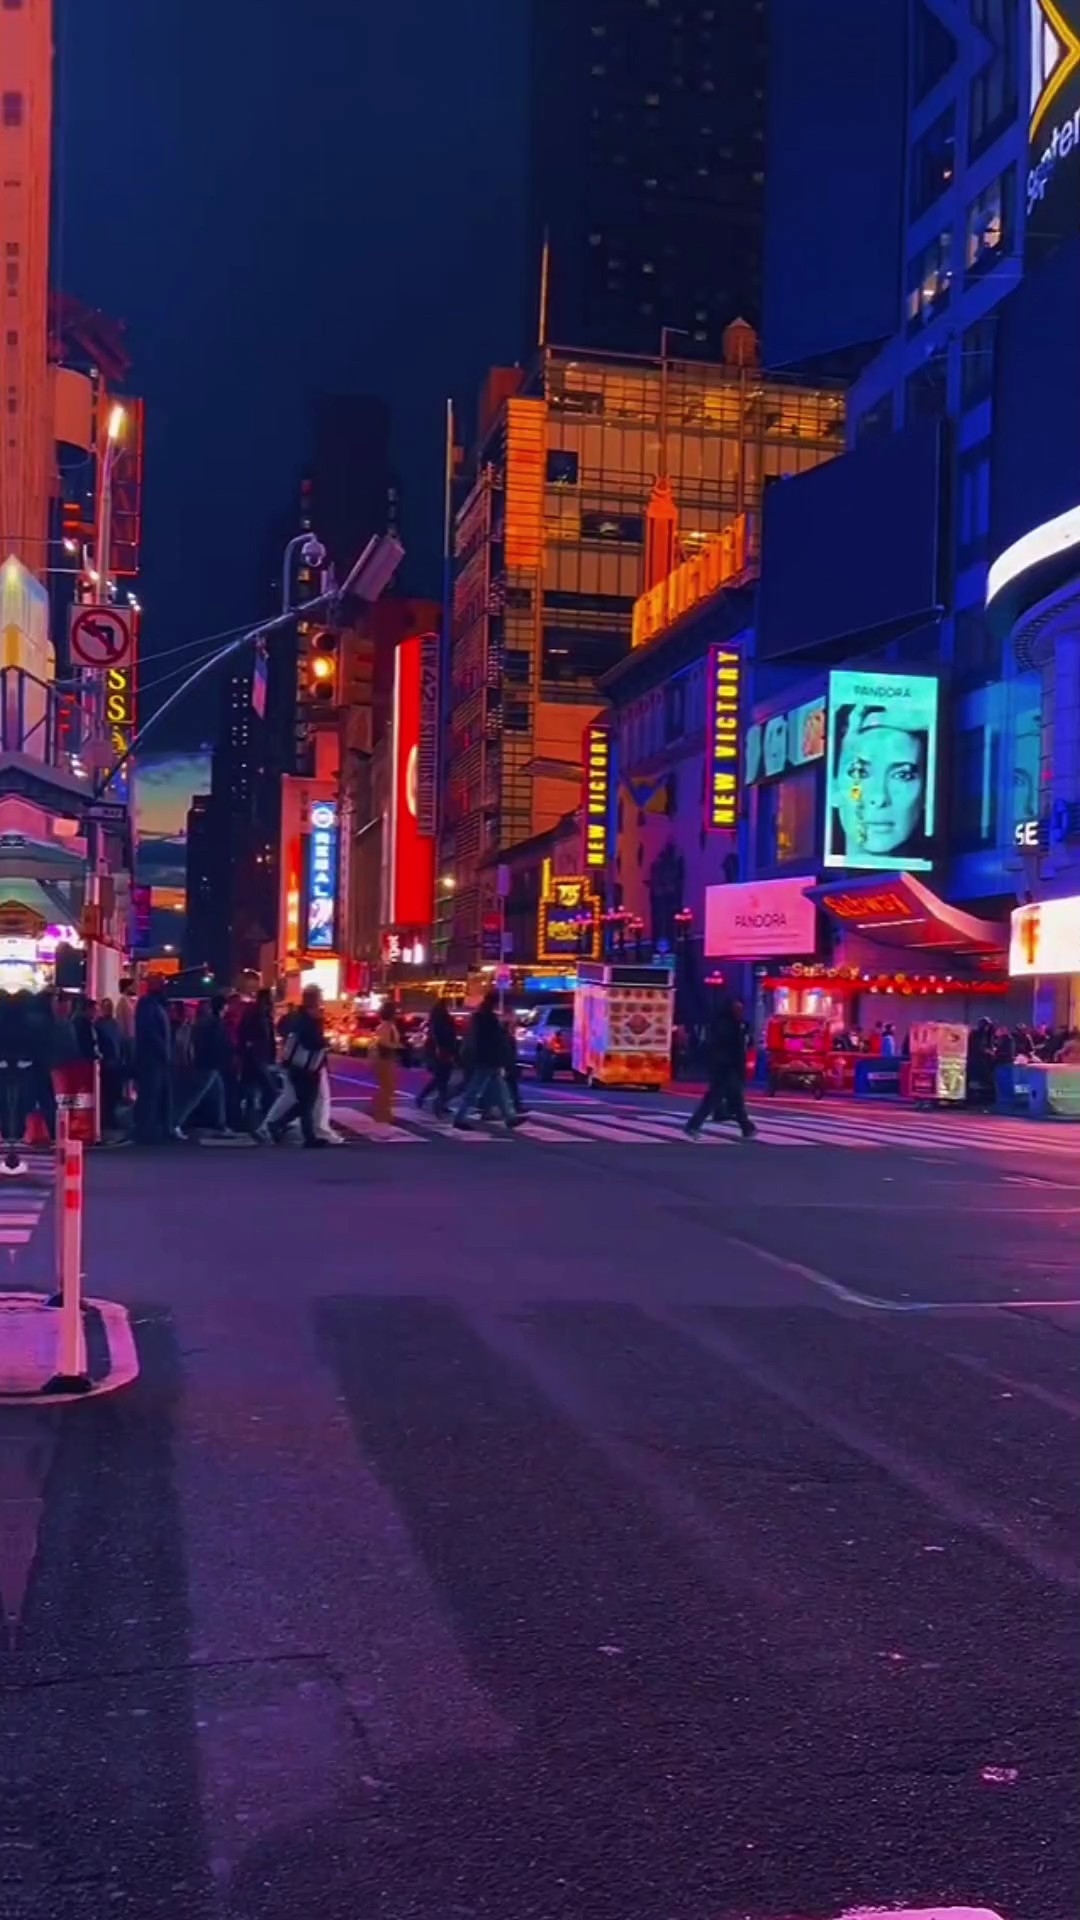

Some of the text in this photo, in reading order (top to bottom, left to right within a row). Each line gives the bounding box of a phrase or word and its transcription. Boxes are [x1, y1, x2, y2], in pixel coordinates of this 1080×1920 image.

[853, 685, 912, 698] PANDORA
[713, 650, 740, 824] NEW VICTORY
[587, 730, 608, 865] NEW VICTORY
[735, 913, 787, 928] PANDORA
